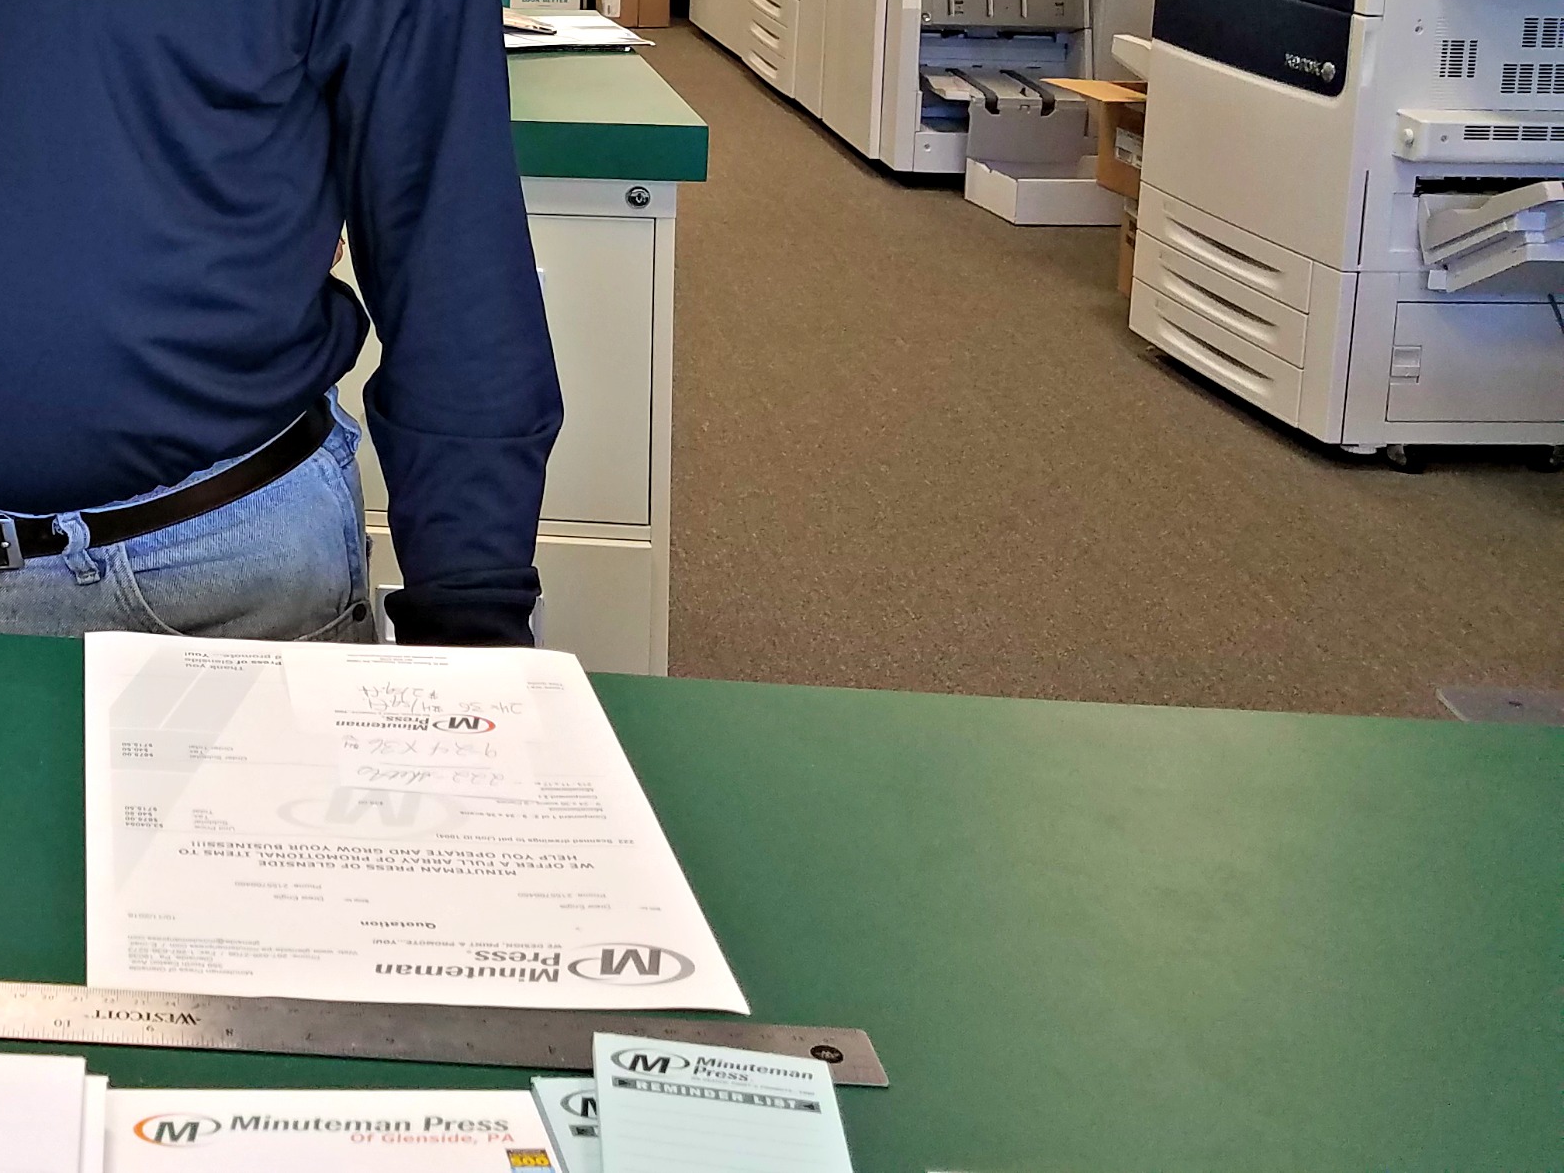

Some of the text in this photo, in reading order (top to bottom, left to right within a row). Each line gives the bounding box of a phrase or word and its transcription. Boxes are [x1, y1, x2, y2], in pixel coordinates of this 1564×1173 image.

[1285, 53, 1321, 76] xerox
[336, 720, 429, 731] Minuteman
[203, 849, 251, 858] ITEMS
[290, 845, 331, 853] YOUR
[335, 846, 384, 855] GROW
[425, 849, 496, 858] OPERATE
[255, 851, 371, 861] PROMOTIONAL
[257, 860, 336, 869] GLENSIDE
[364, 864, 415, 872] PRESS
[514, 861, 564, 869] OFFER
[419, 867, 516, 876] MINUTEMAN
[359, 920, 437, 930] Quotation
[375, 963, 560, 982] Minuteman
[92, 1008, 198, 1027] WESTCOTT
[53, 1018, 72, 1028] 10
[695, 1056, 814, 1081] Minuteman
[693, 1066, 749, 1083] Press
[635, 1079, 798, 1110] REMINDER LIST
[229, 1114, 510, 1133] Minuteman Press
[349, 1133, 516, 1145] Of Glenside, PA
